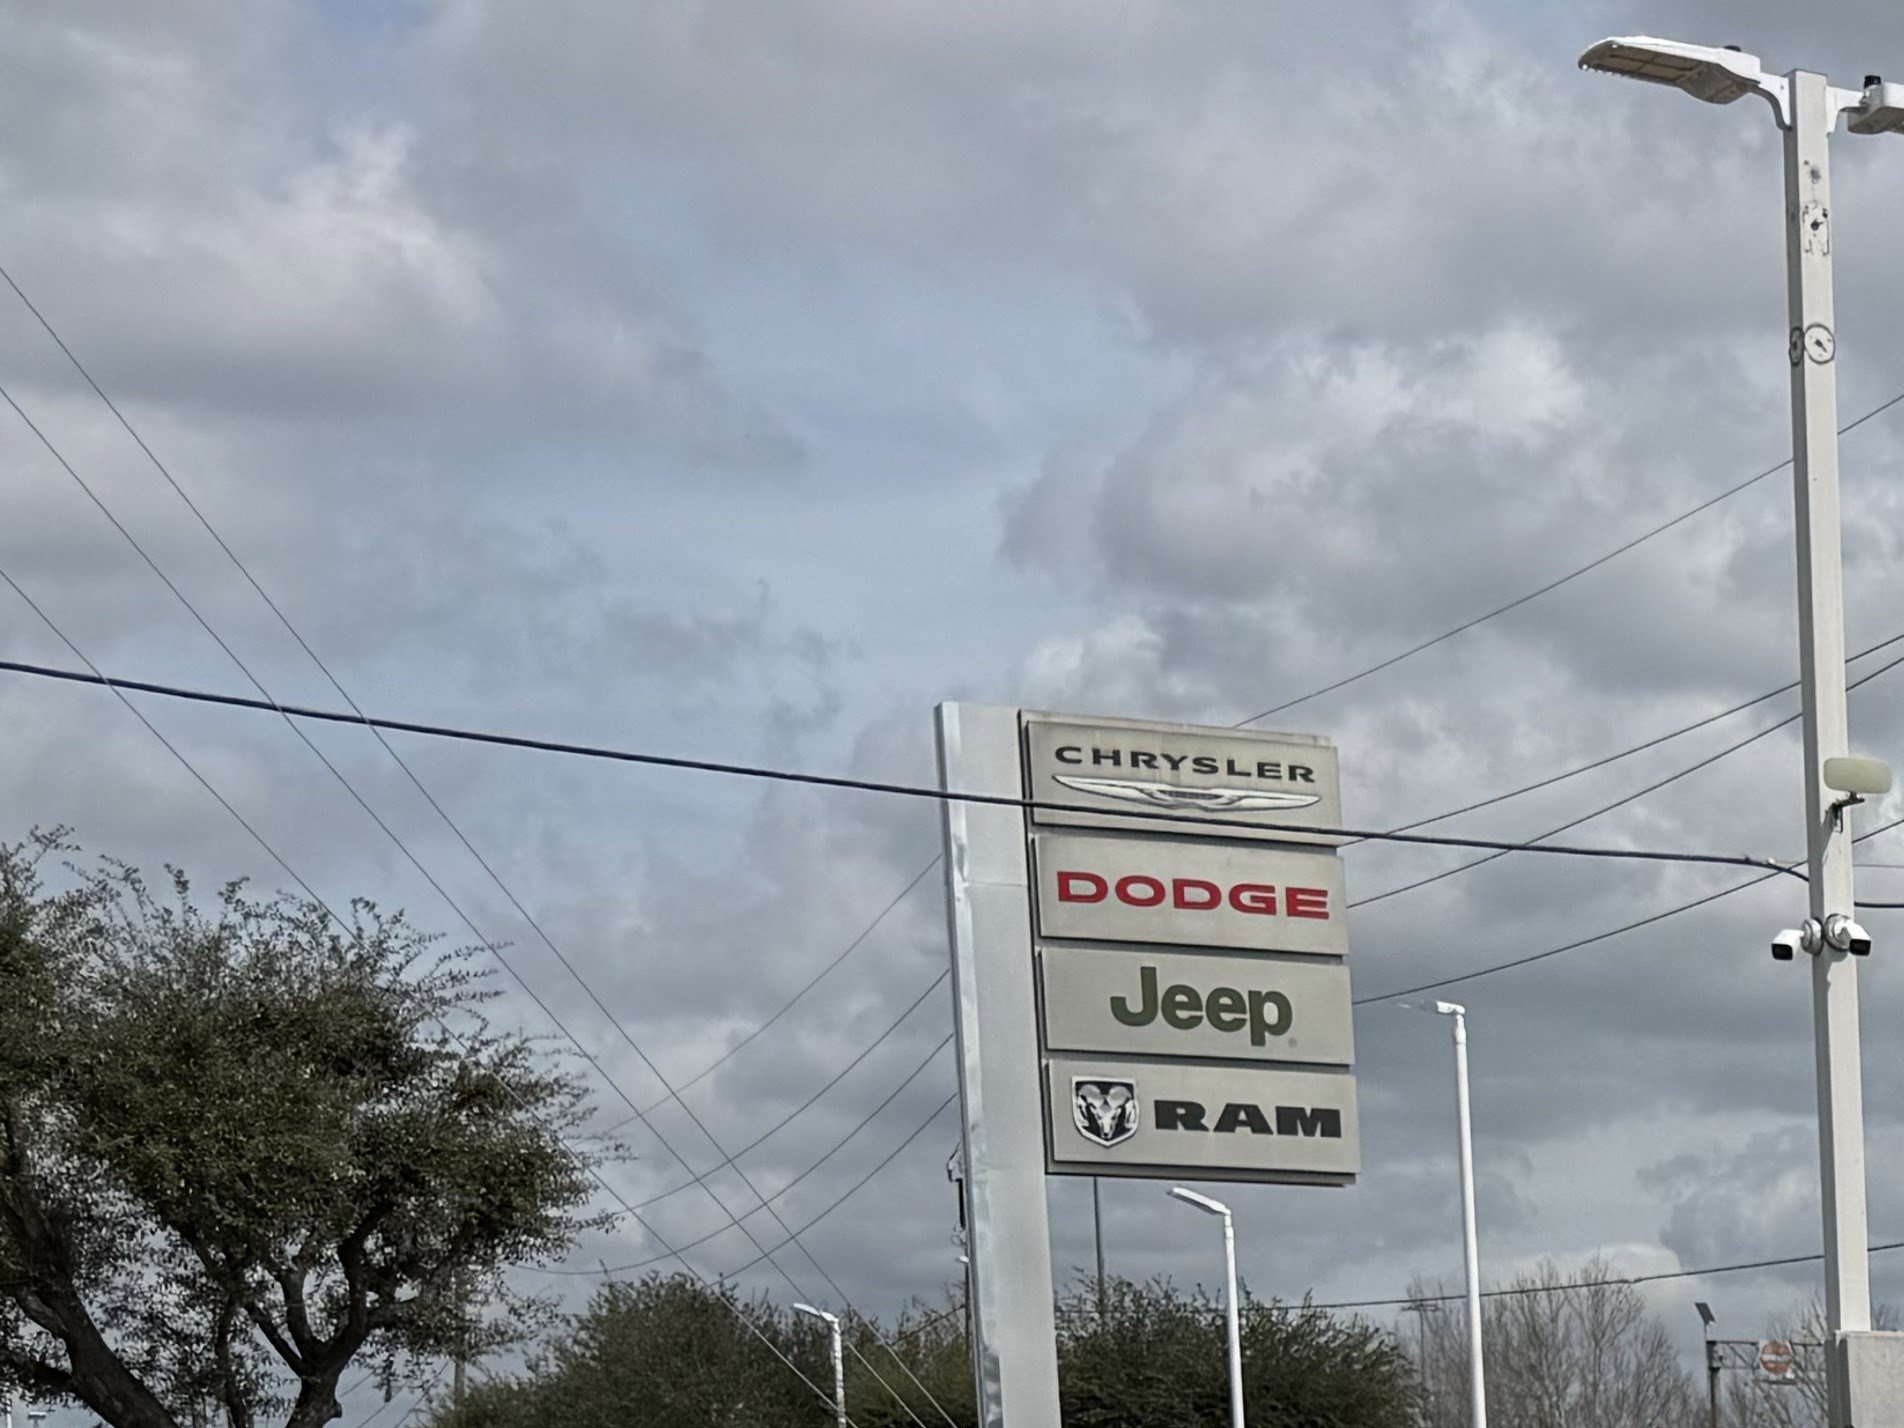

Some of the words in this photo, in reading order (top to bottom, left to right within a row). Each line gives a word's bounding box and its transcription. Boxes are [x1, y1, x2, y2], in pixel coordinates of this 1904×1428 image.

[1055, 746, 1315, 783] CHRYSLER
[1057, 870, 1330, 920] DODGE
[1110, 966, 1293, 1047] Jeep
[1154, 1100, 1342, 1138] RAM
